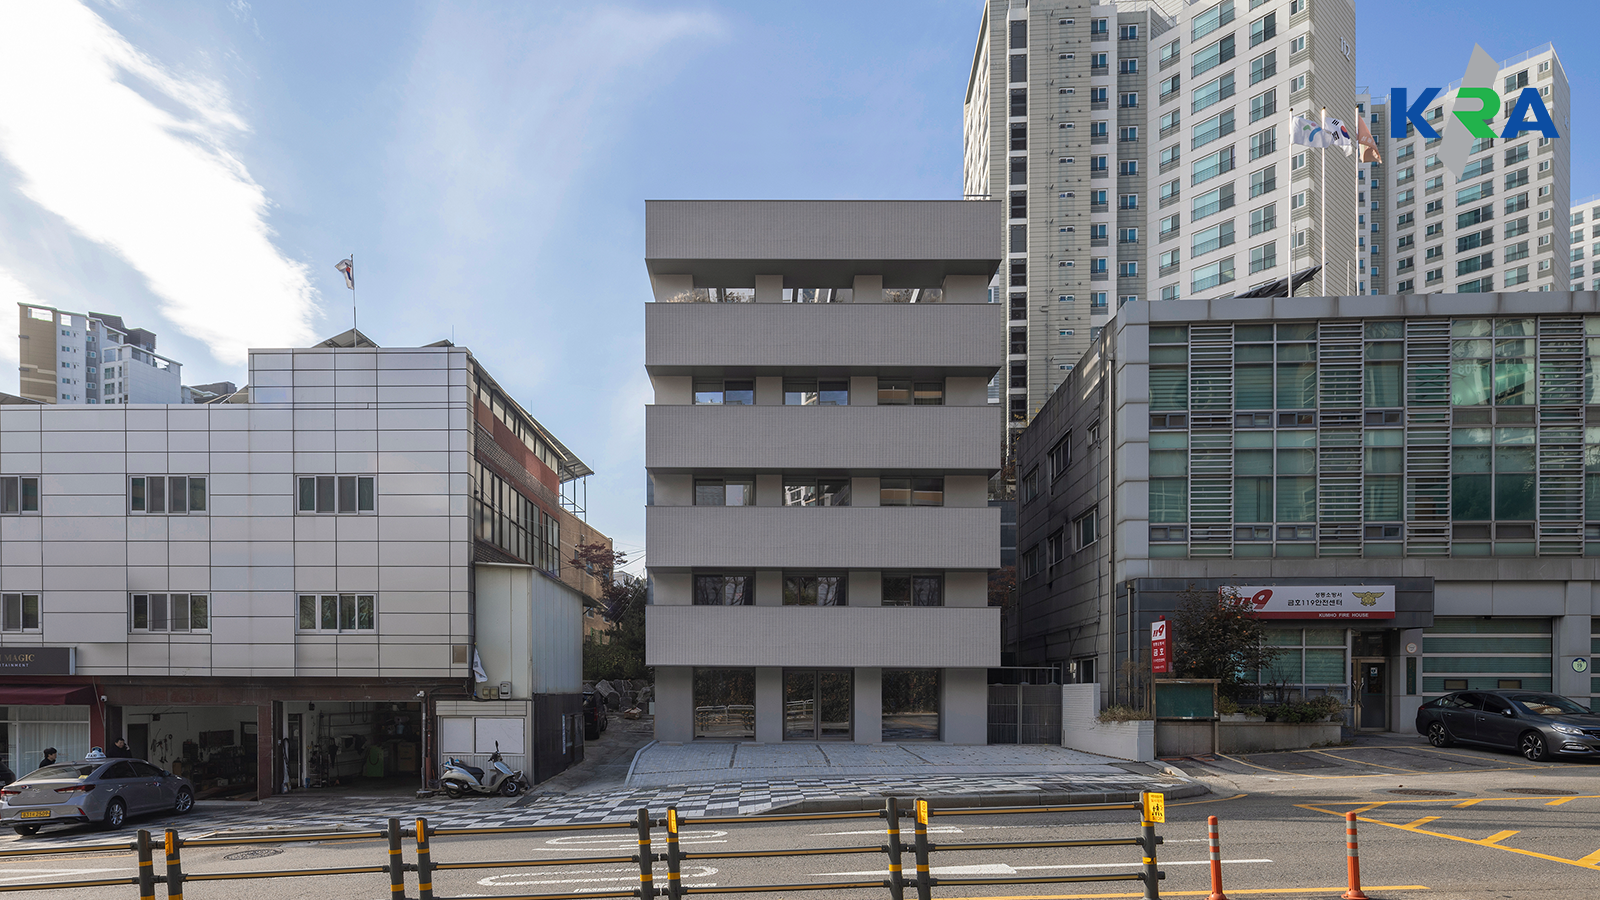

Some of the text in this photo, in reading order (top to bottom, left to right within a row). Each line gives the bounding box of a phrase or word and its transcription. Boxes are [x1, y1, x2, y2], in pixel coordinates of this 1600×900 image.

[1287, 599, 1343, 607] 금호119안전센터
[1152, 624, 1165, 638] 119
[4, 654, 35, 662] MAGIC
